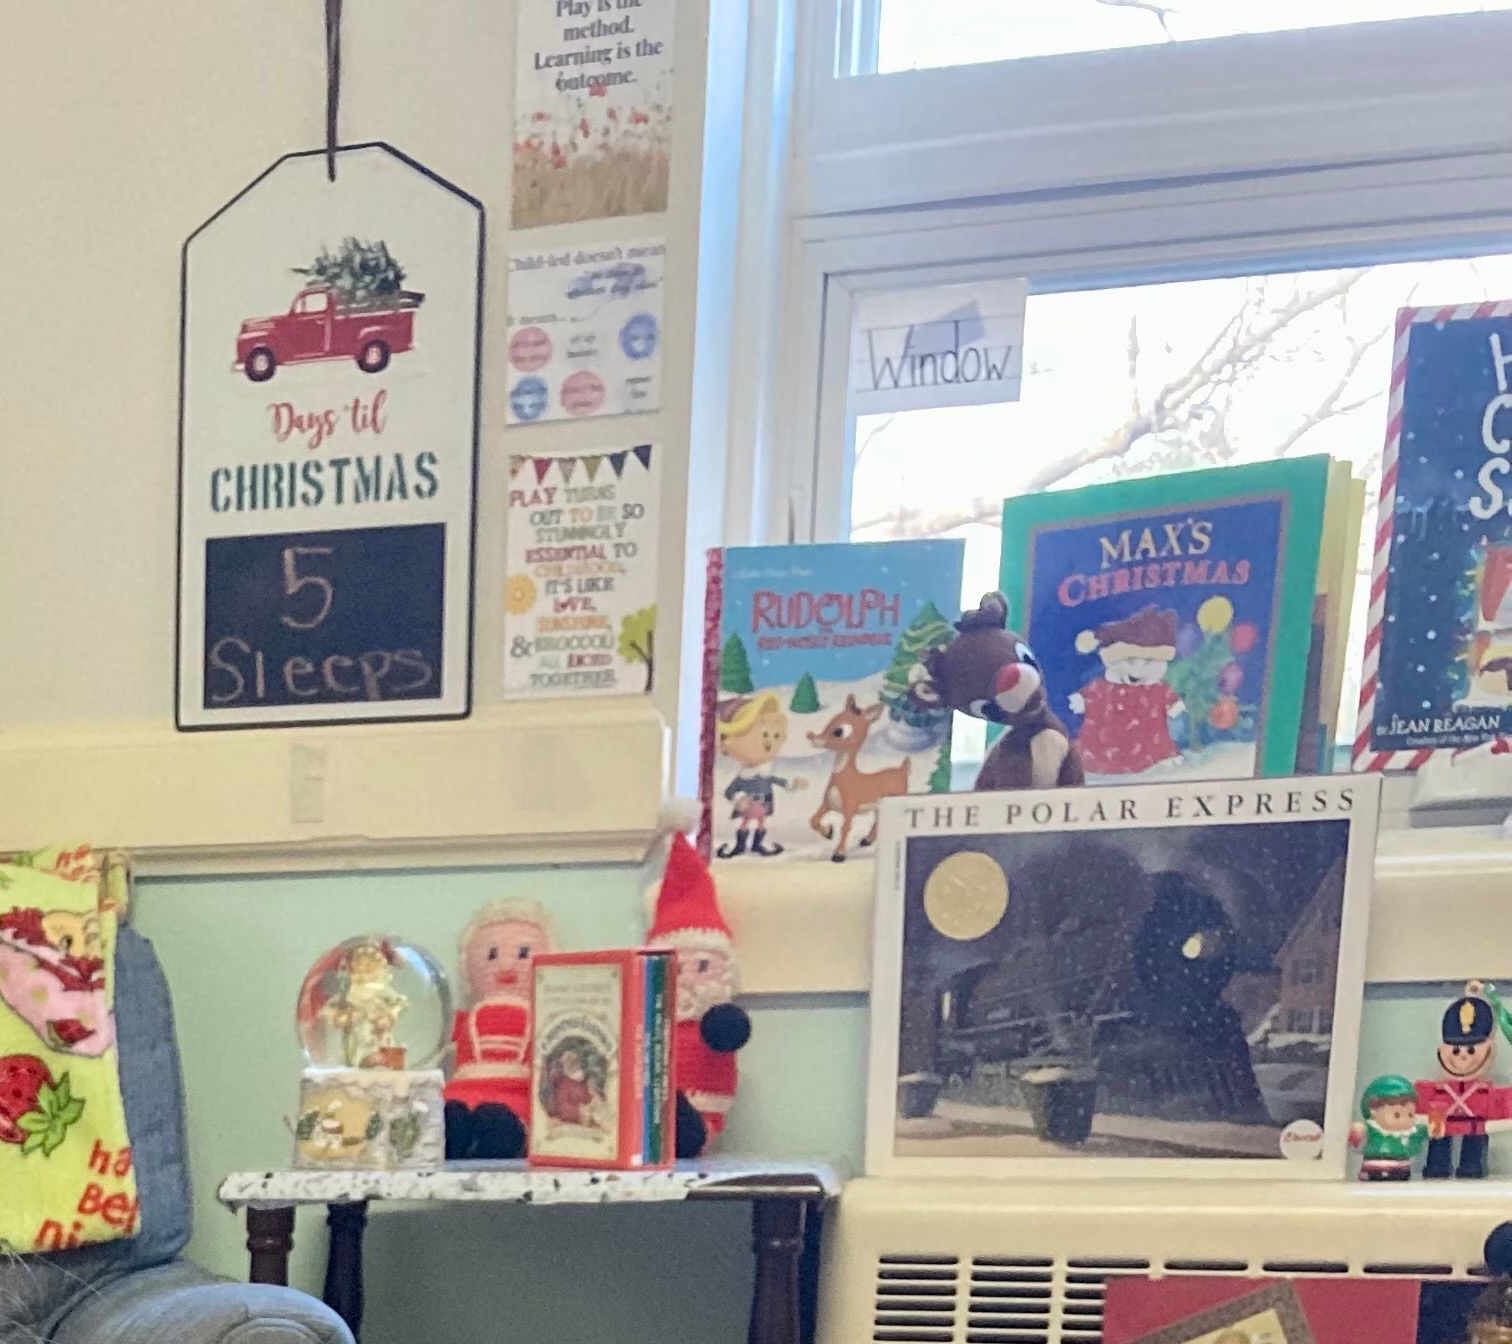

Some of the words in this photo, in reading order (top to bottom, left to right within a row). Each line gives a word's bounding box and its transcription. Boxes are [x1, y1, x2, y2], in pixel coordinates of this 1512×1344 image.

[556, 0, 591, 18] Play
[564, 14, 635, 41] method.
[534, 45, 613, 70] Learning
[616, 41, 632, 60] is
[635, 38, 664, 57] the
[555, 70, 638, 92] outcome.
[867, 319, 1013, 391] Window
[265, 400, 340, 450] Days
[210, 451, 440, 513] CHRISTMAS
[508, 486, 557, 509] PLAY
[530, 508, 564, 527] OUT
[568, 506, 594, 523] TO
[622, 502, 646, 521] SO
[612, 541, 638, 559] TO
[1098, 516, 1213, 571] MAX'S
[280, 546, 334, 631] 5
[1058, 558, 1252, 608] CHRISTMAS
[752, 588, 901, 633] RUDOLPH
[211, 636, 434, 702] Sleeps
[1389, 713, 1430, 736] JEAN
[1433, 715, 1501, 733] REAGAN
[905, 805, 980, 829] THE
[1005, 798, 1139, 825] POLAR
[1166, 787, 1355, 820] EXPRESS
